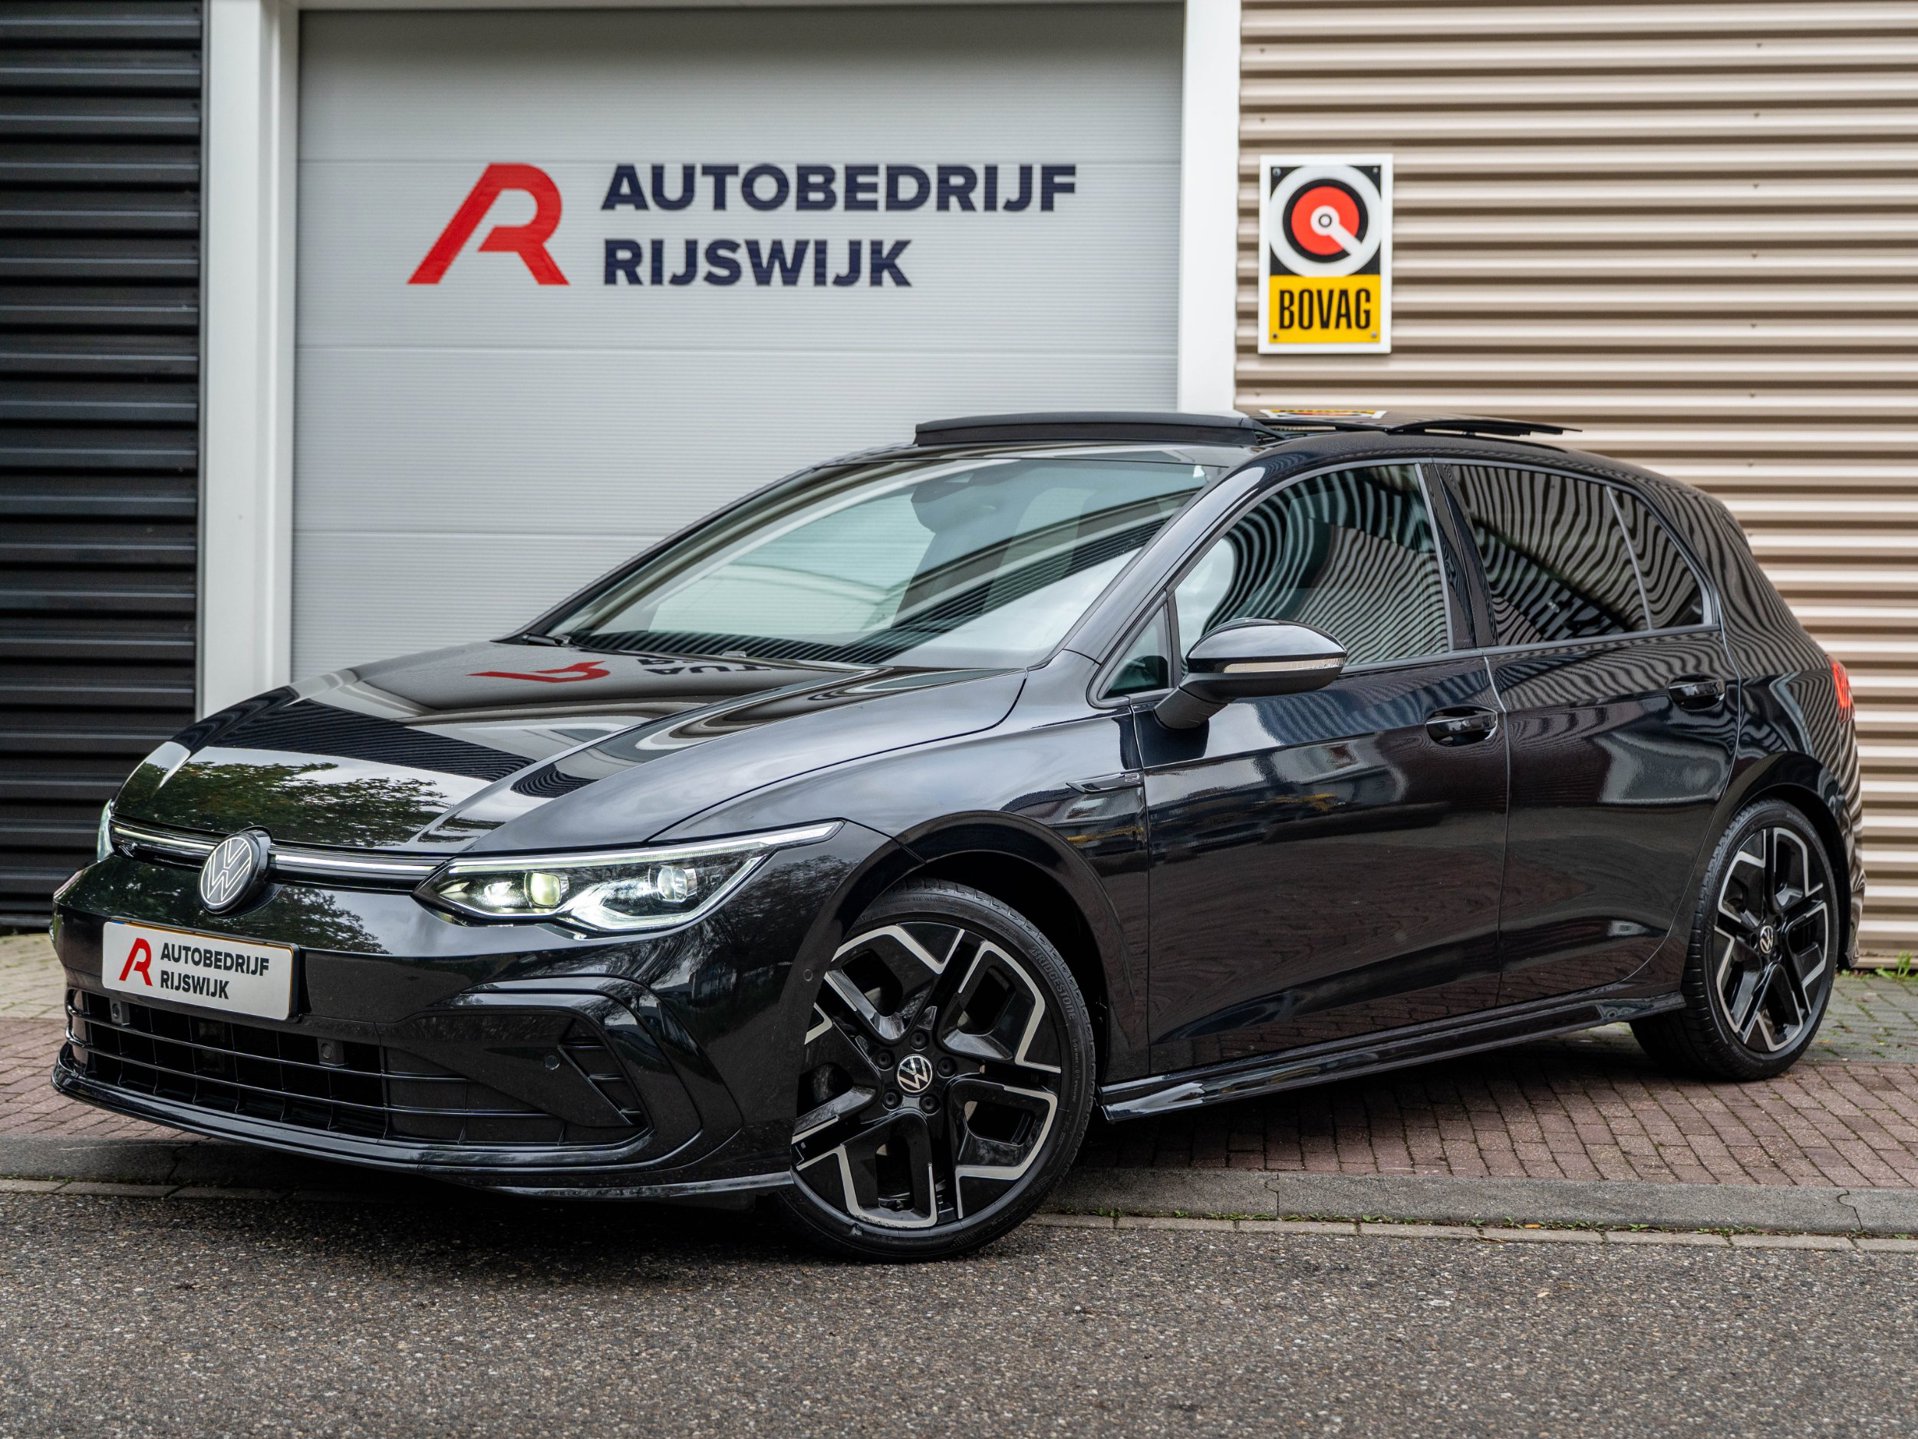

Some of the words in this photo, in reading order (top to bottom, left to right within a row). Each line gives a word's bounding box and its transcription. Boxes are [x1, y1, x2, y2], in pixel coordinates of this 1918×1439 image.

[601, 164, 1076, 212] AUTOBEDRIJF
[603, 239, 912, 287] RIJSWIJK
[1279, 288, 1371, 330] BOVAG
[160, 942, 270, 977] AUTOBEDRIJF
[160, 970, 230, 1000] RIJSWIJK
[1028, 946, 1077, 1020] BRIDGESTONE
